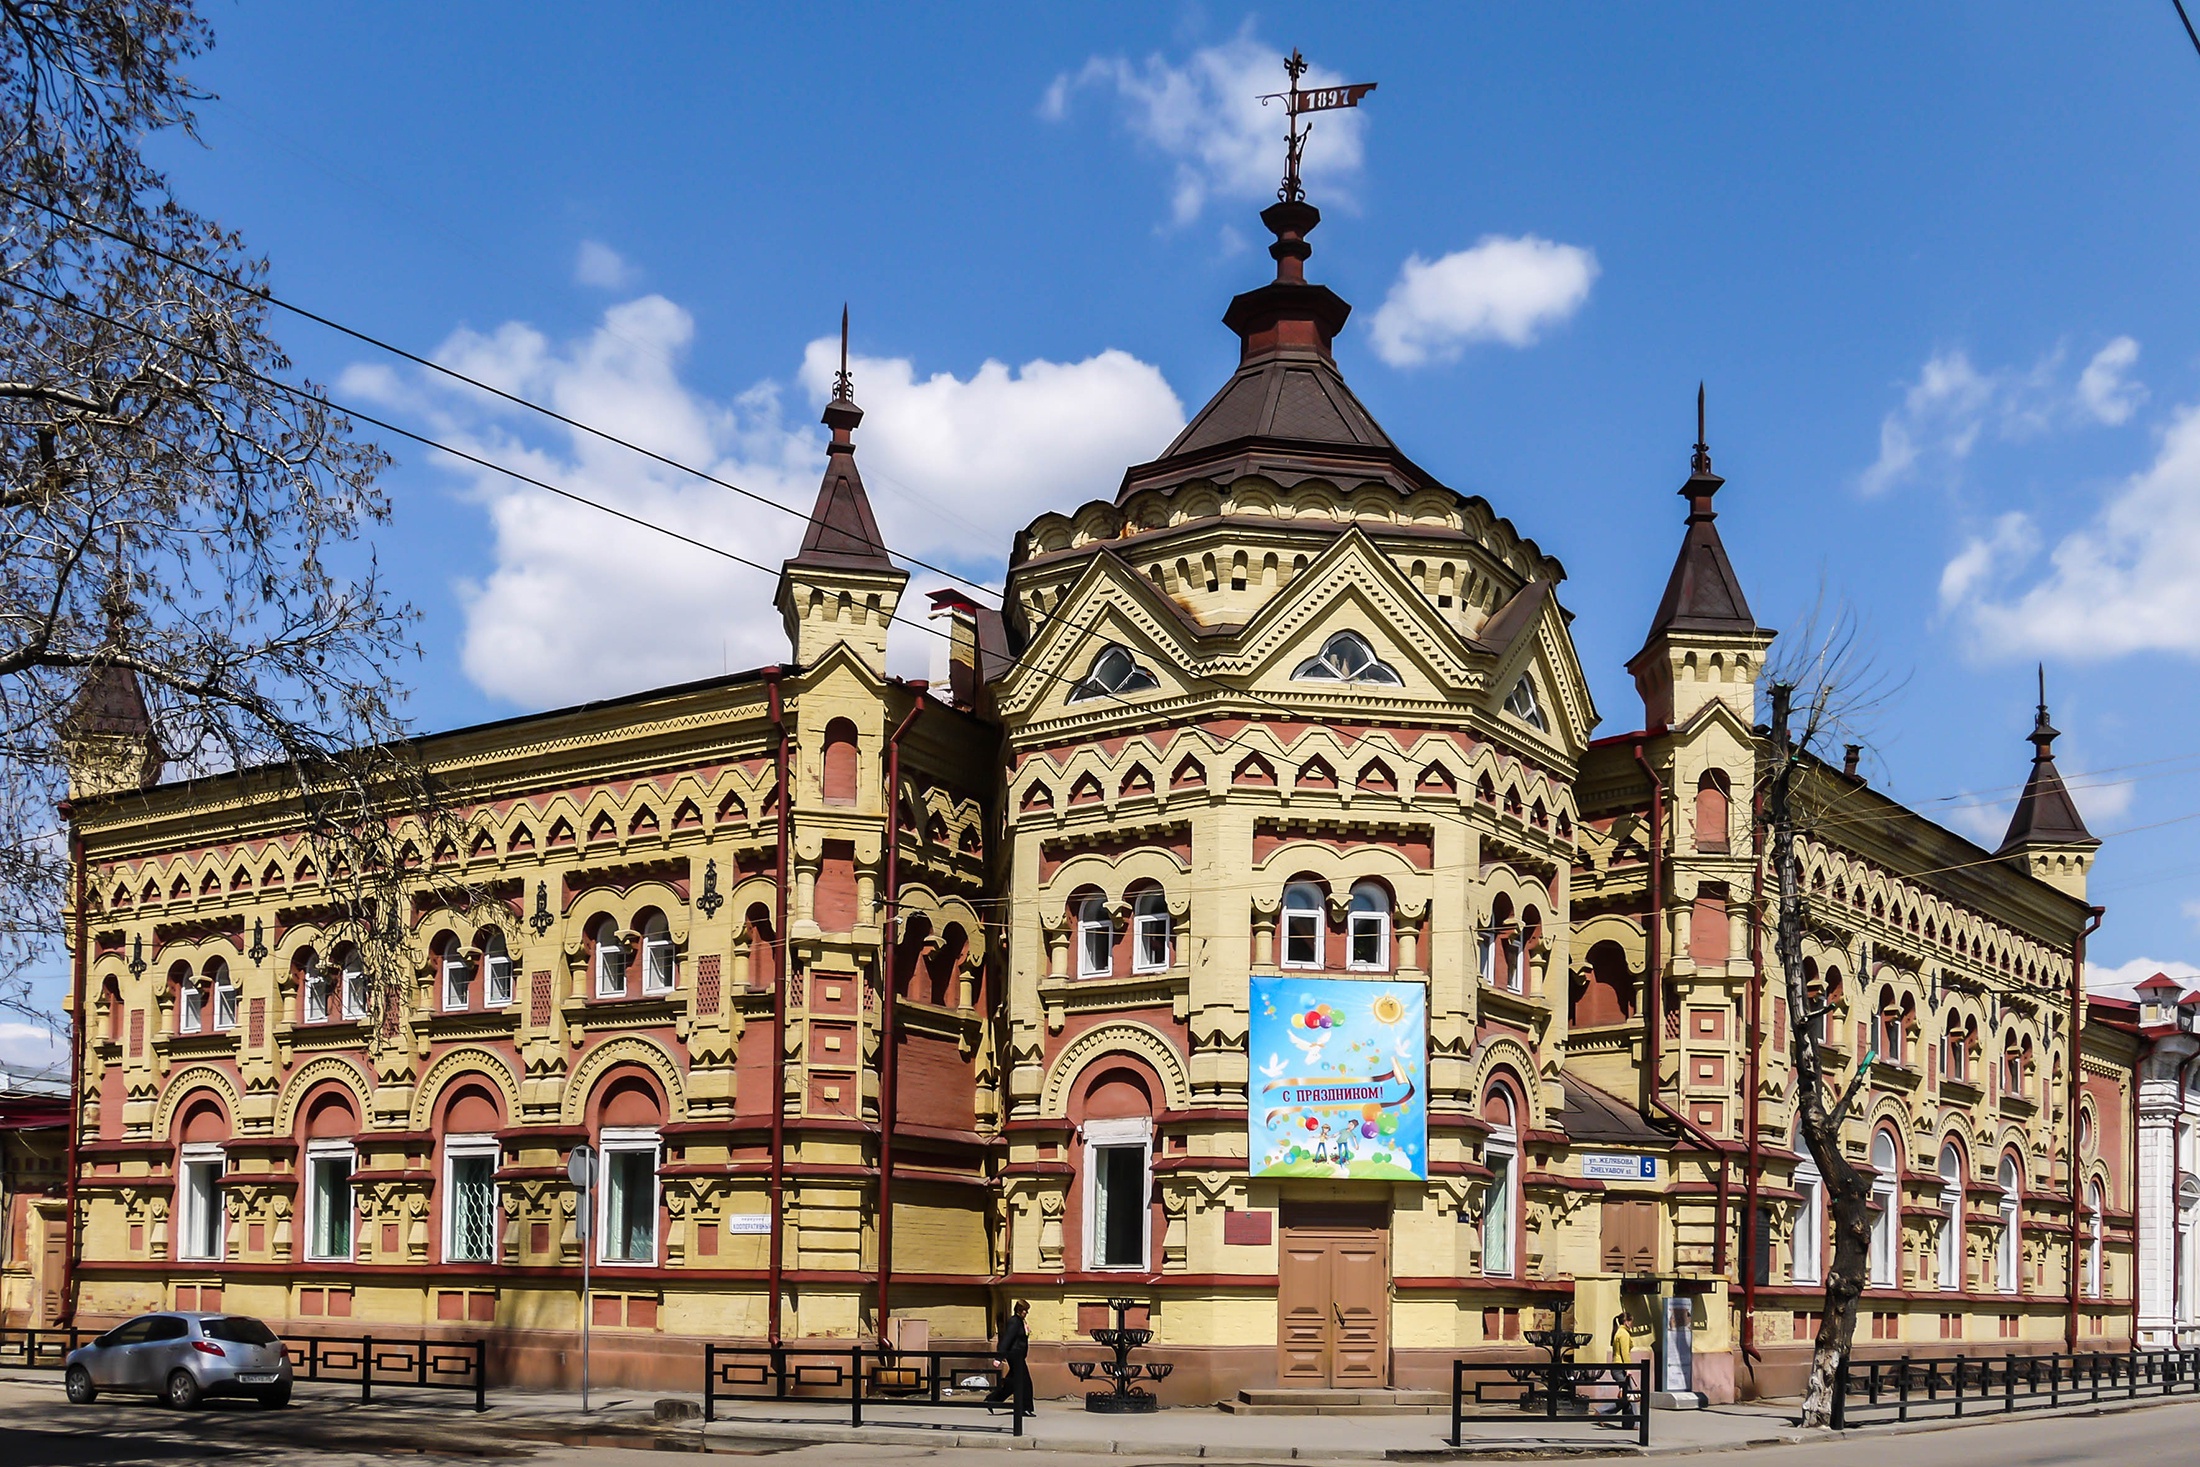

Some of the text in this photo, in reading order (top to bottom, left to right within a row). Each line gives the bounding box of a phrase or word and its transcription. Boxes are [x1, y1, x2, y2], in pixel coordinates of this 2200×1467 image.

[1306, 89, 1350, 109] 1897
[1282, 1086, 1384, 1102] С ПРАЗДНИКОМ!
[1644, 1161, 1652, 1174] 5
